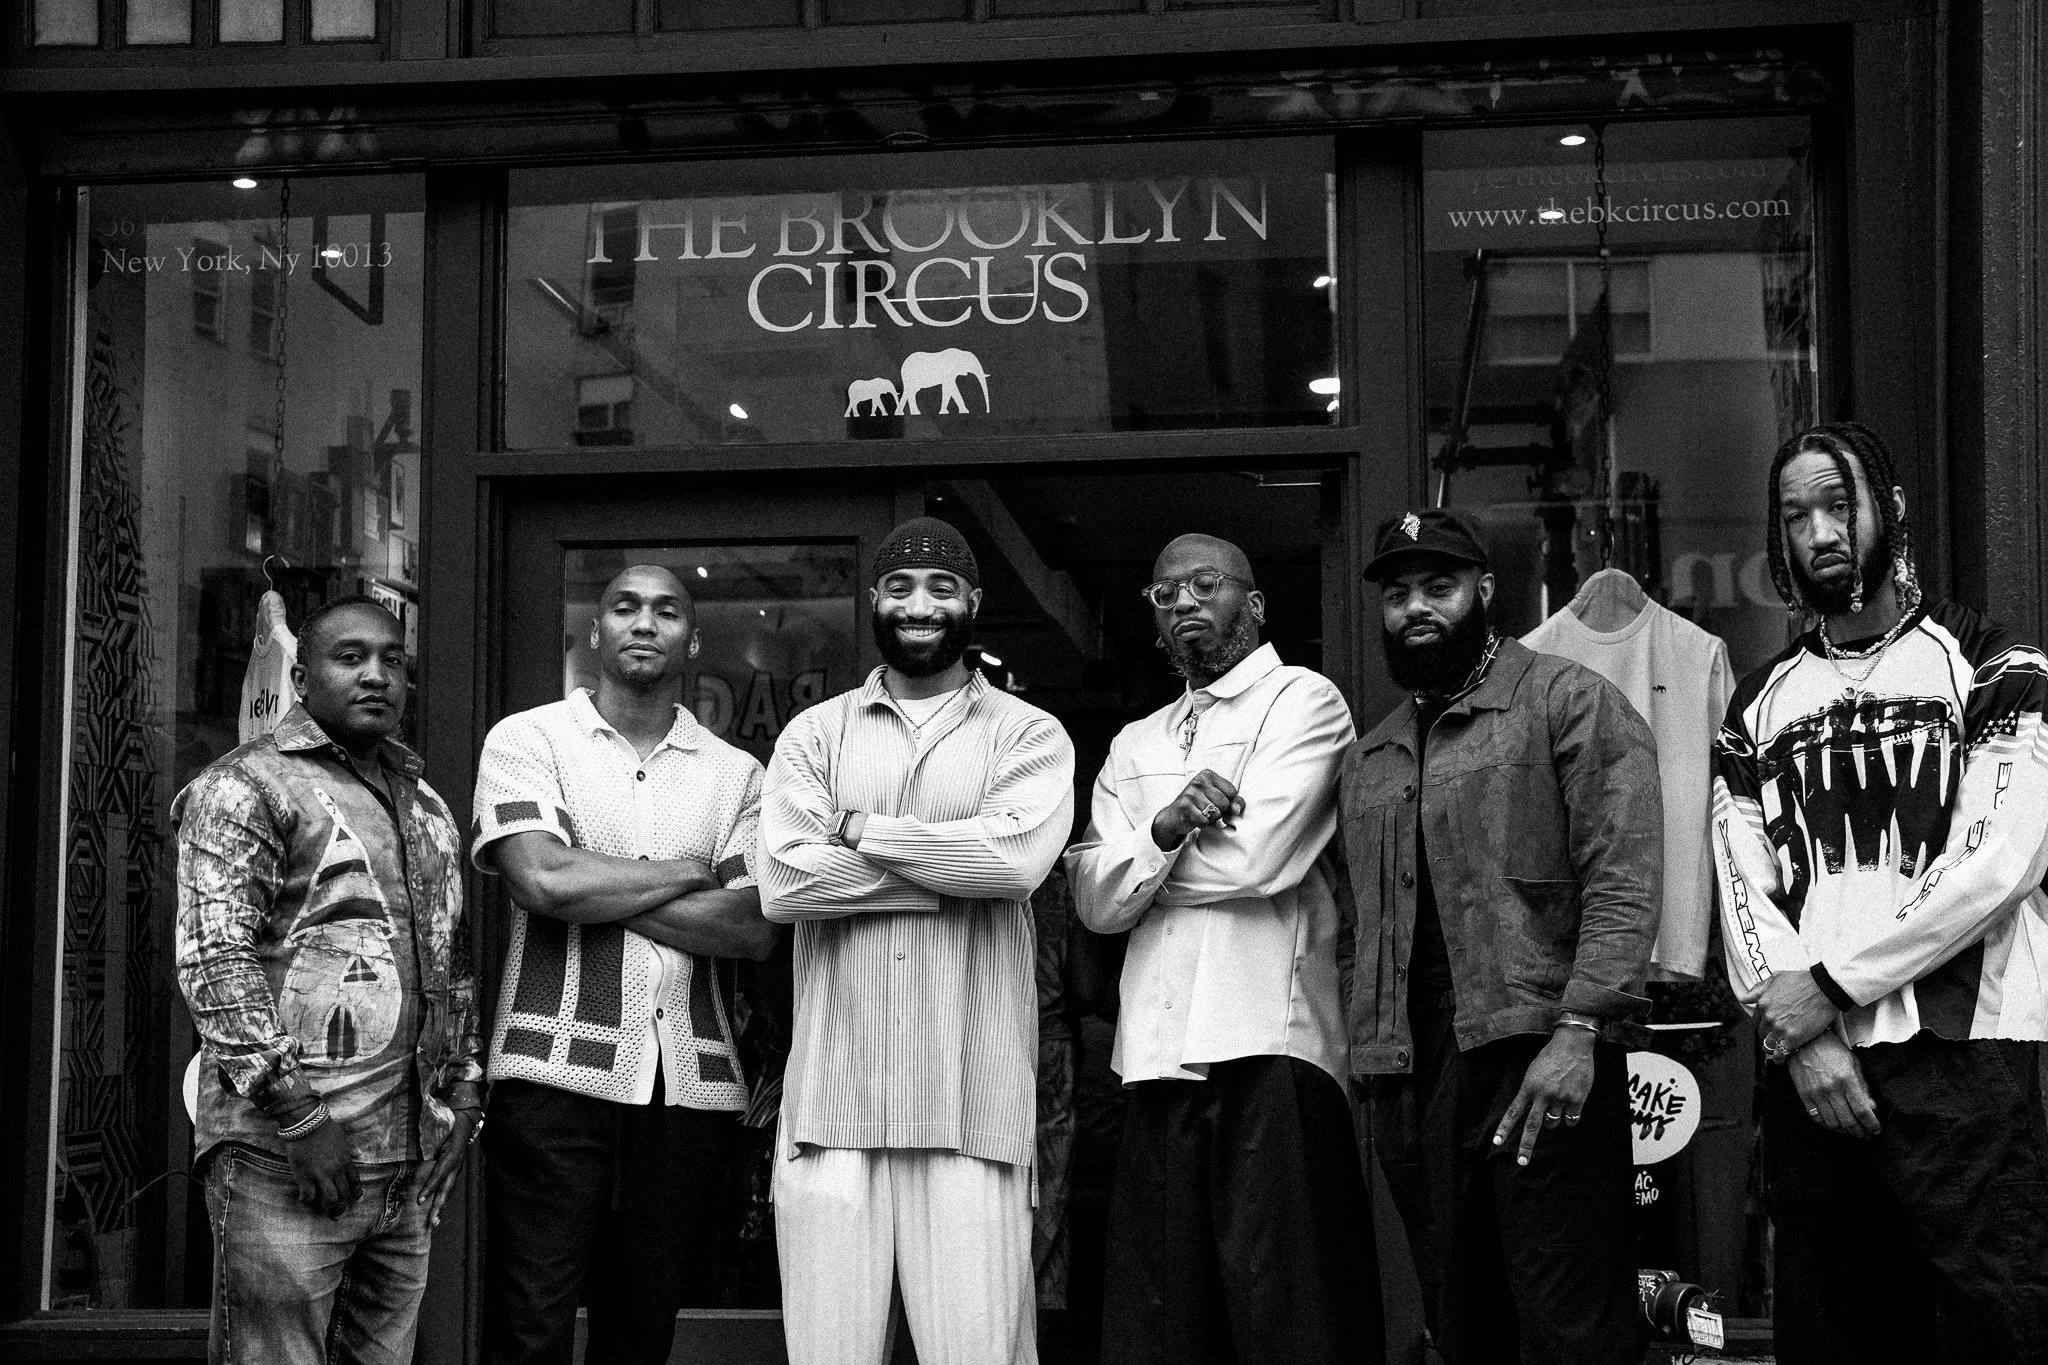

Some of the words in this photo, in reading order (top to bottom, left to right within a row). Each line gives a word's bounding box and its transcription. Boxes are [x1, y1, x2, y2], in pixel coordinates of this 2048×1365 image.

[586, 202, 757, 263] THE
[773, 176, 1267, 256] BROOKLYN
[1447, 196, 1792, 228] www.thebkcircus.com
[102, 246, 167, 274] New
[176, 244, 251, 276] York,
[258, 244, 303, 276] Ny
[312, 242, 393, 269] 10013
[747, 252, 1089, 332] CIRCUS
